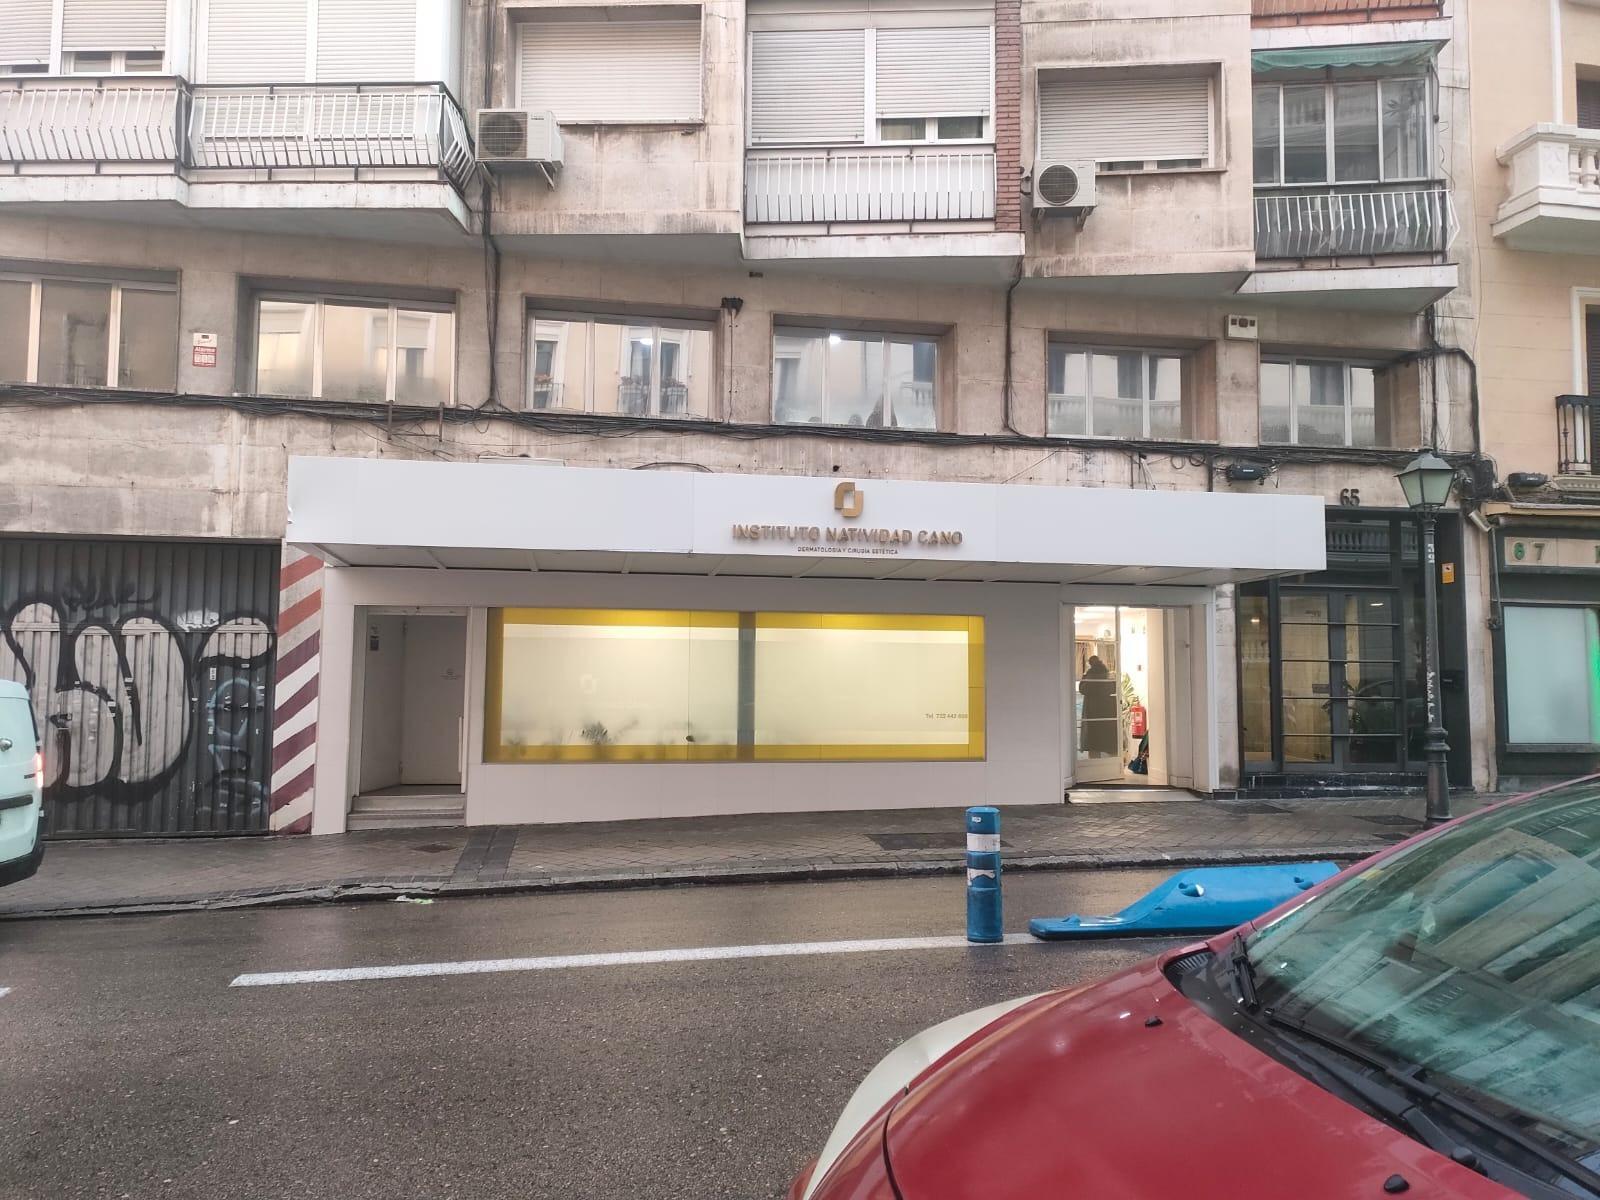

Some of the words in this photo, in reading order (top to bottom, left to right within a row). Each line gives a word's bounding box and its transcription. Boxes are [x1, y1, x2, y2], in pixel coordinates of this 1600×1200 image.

[1340, 488, 1360, 506] 65
[732, 524, 820, 541] INSTITUTO
[826, 527, 913, 544] NATIVIDAD
[917, 530, 963, 545] CANO
